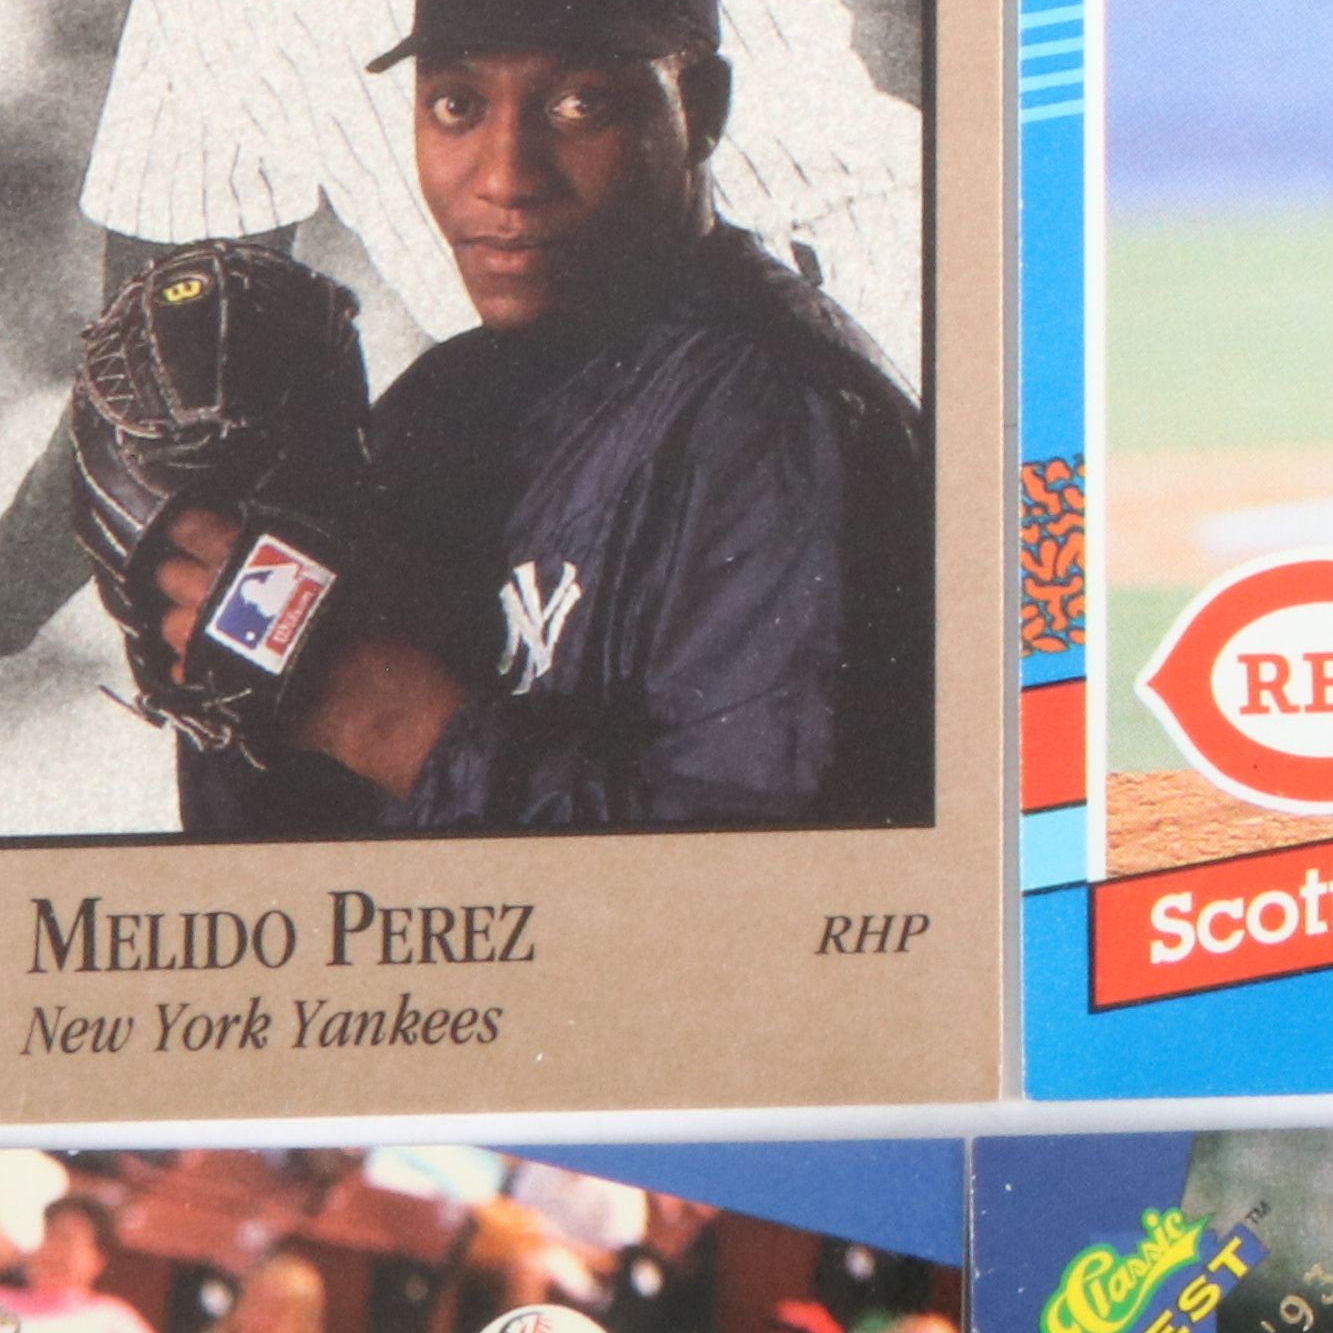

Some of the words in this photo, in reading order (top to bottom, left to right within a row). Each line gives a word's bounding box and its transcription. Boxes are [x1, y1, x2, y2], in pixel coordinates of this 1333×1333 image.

[27, 898, 297, 973] MELIDO
[326, 890, 537, 968] PEREZ
[814, 913, 931, 956] RHP
[20, 1006, 134, 1056] New
[152, 1000, 270, 1053] York
[290, 992, 504, 1049] Yankees
